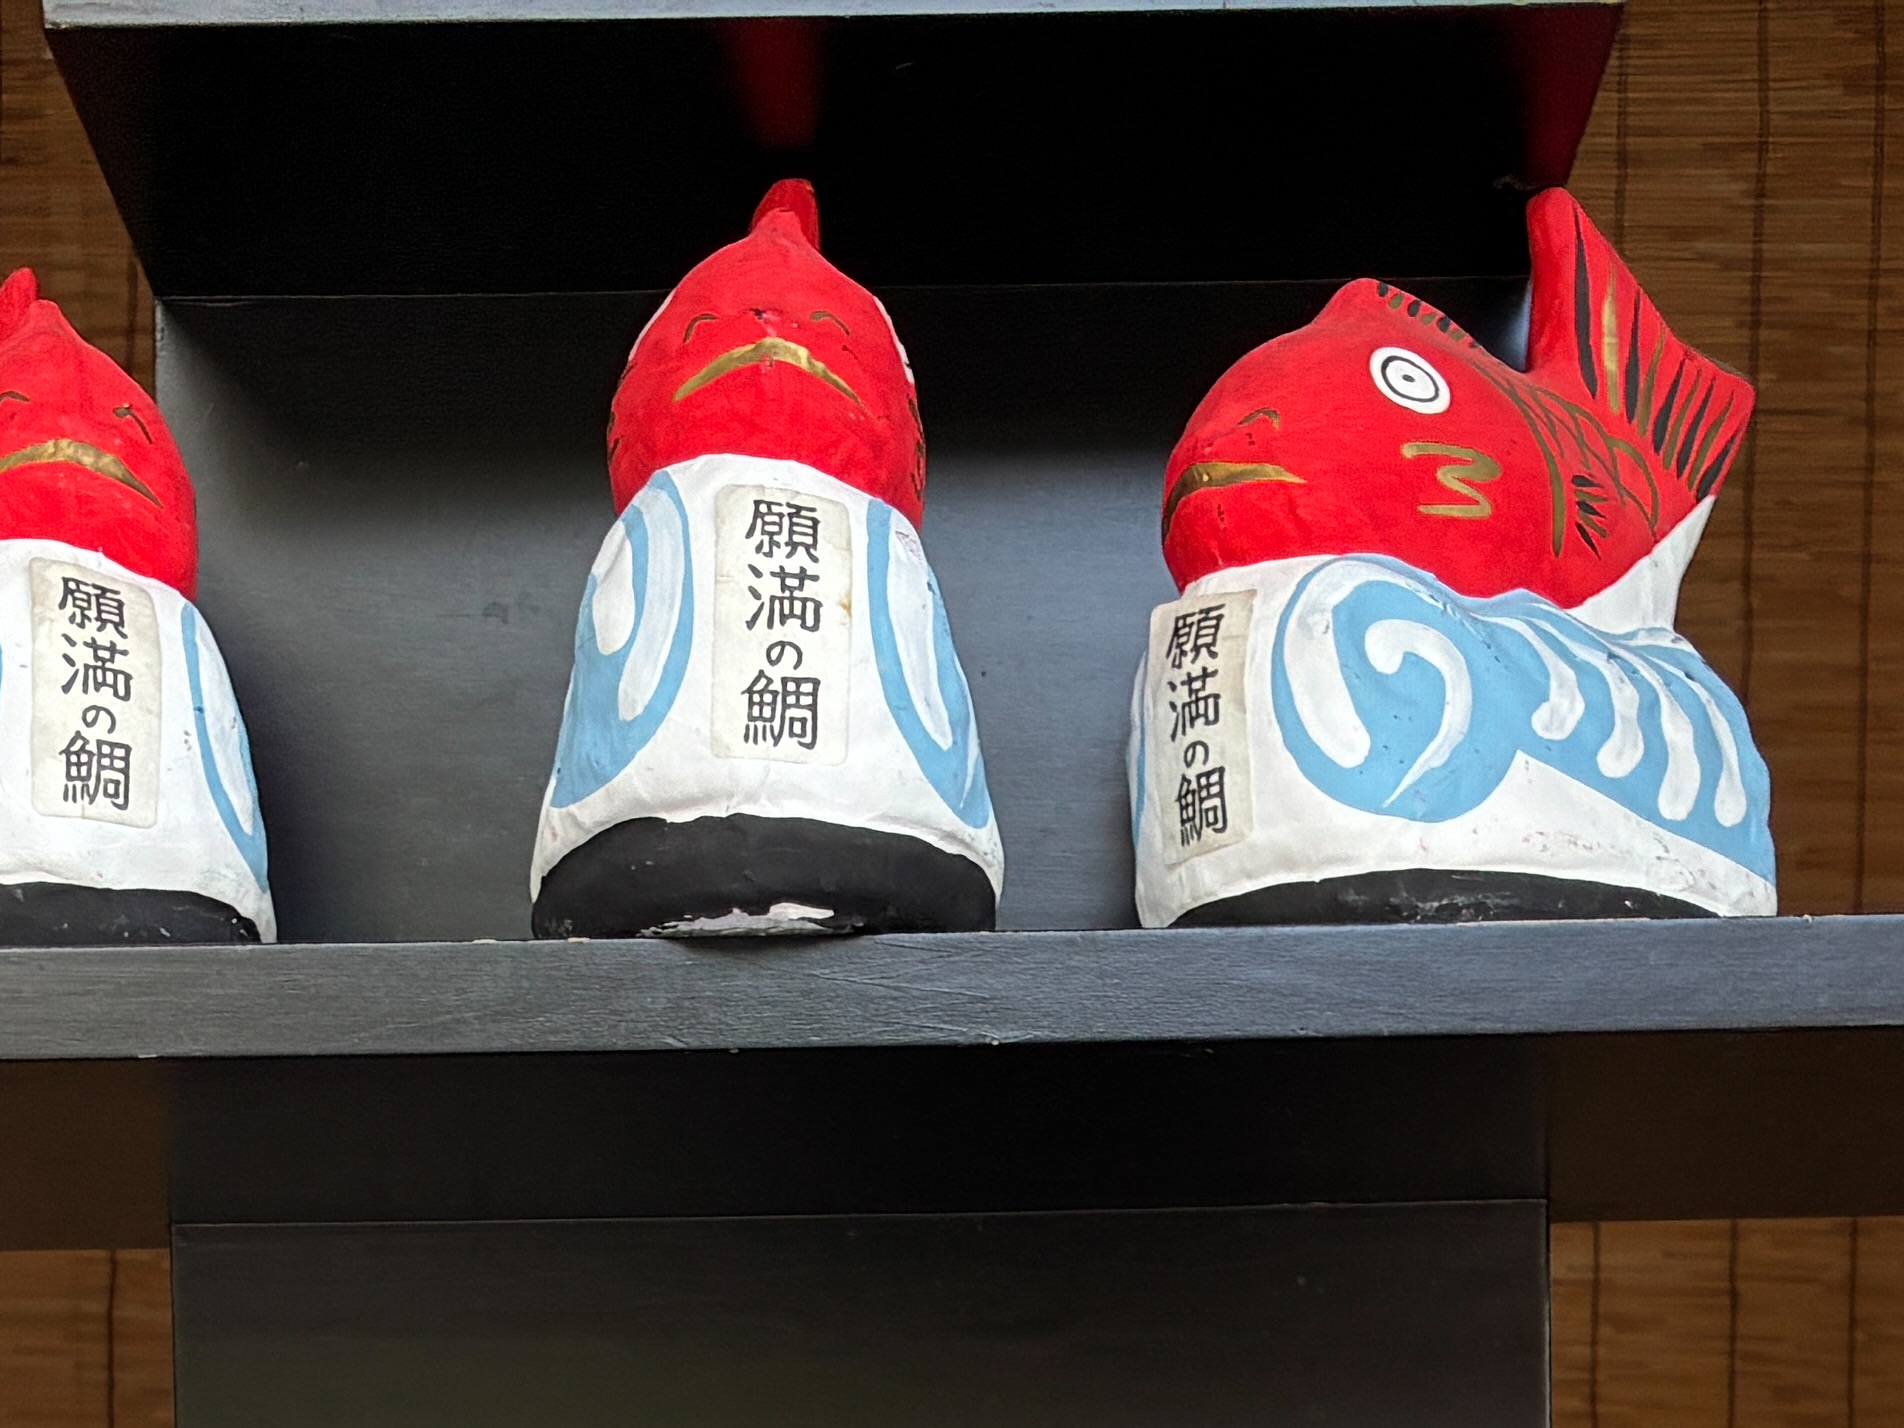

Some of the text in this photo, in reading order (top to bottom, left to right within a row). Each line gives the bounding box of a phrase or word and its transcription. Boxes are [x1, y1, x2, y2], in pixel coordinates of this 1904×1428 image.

[57, 575, 133, 812] 願満の鯛
[742, 498, 822, 751] 願満の鯛
[1165, 603, 1229, 848] 願満の鯛
